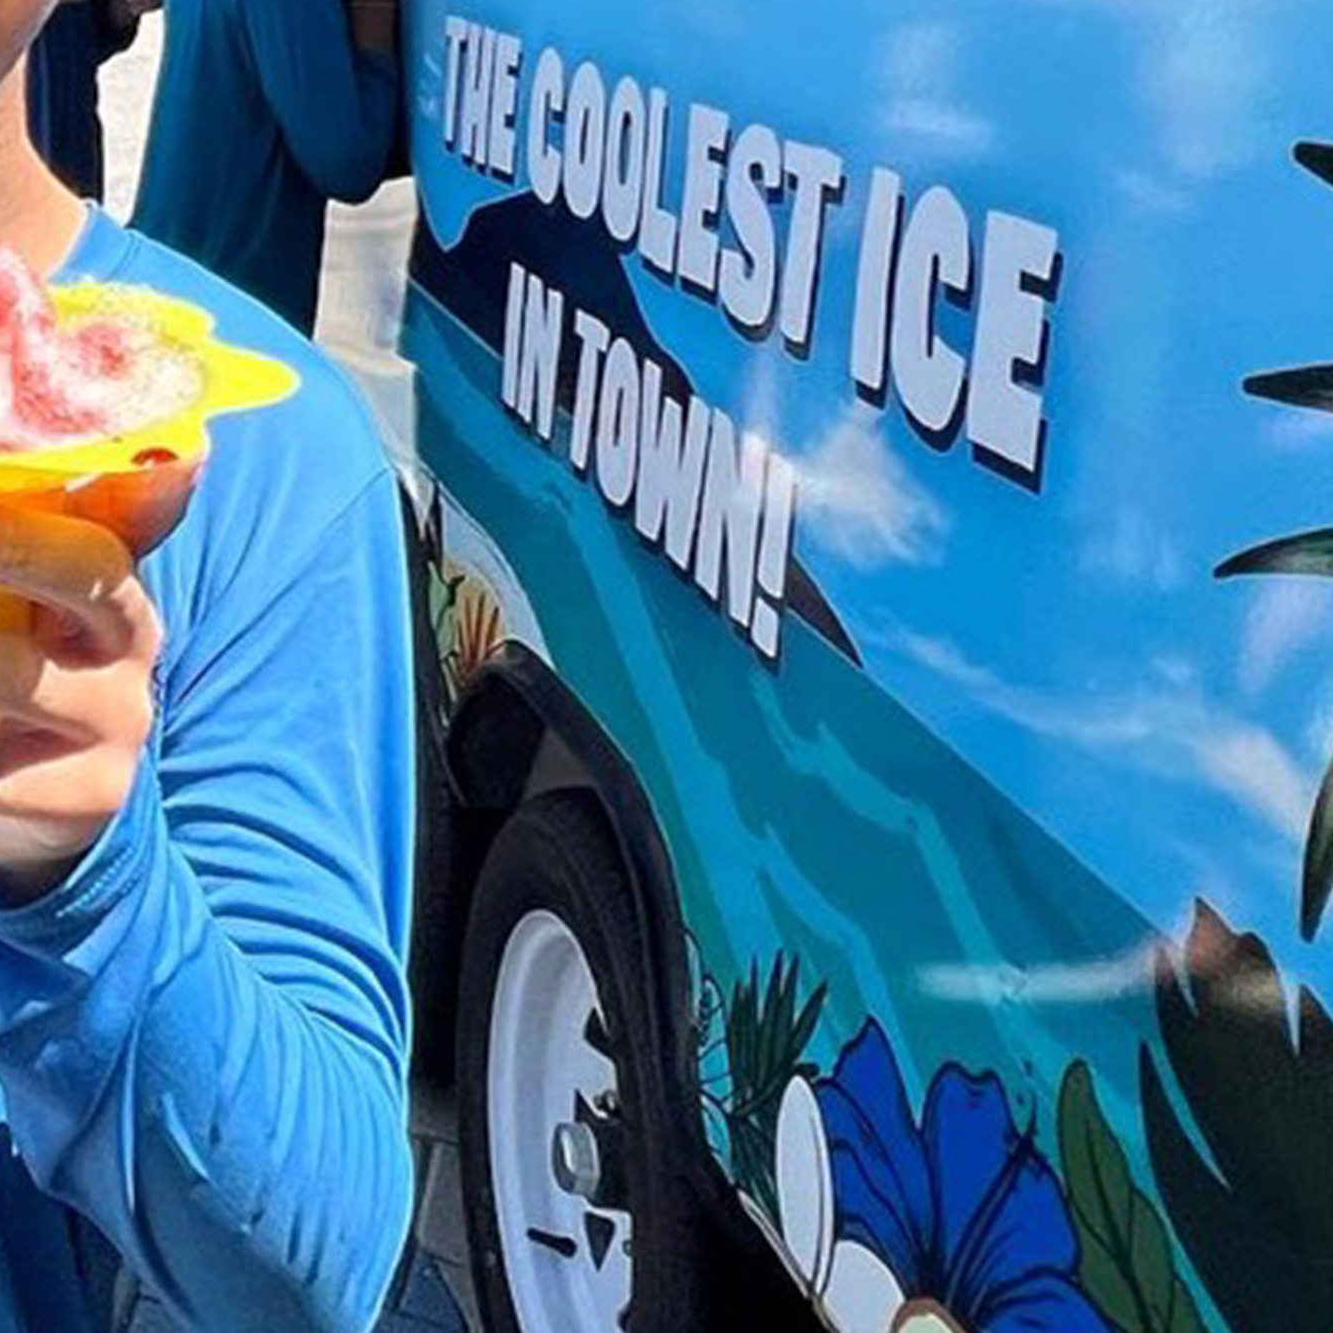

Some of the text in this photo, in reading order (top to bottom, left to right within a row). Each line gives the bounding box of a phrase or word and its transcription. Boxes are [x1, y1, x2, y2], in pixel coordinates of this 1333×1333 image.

[443, 14, 1063, 486] THE COOLEST ICE
[501, 260, 800, 666] IN TOWN!
